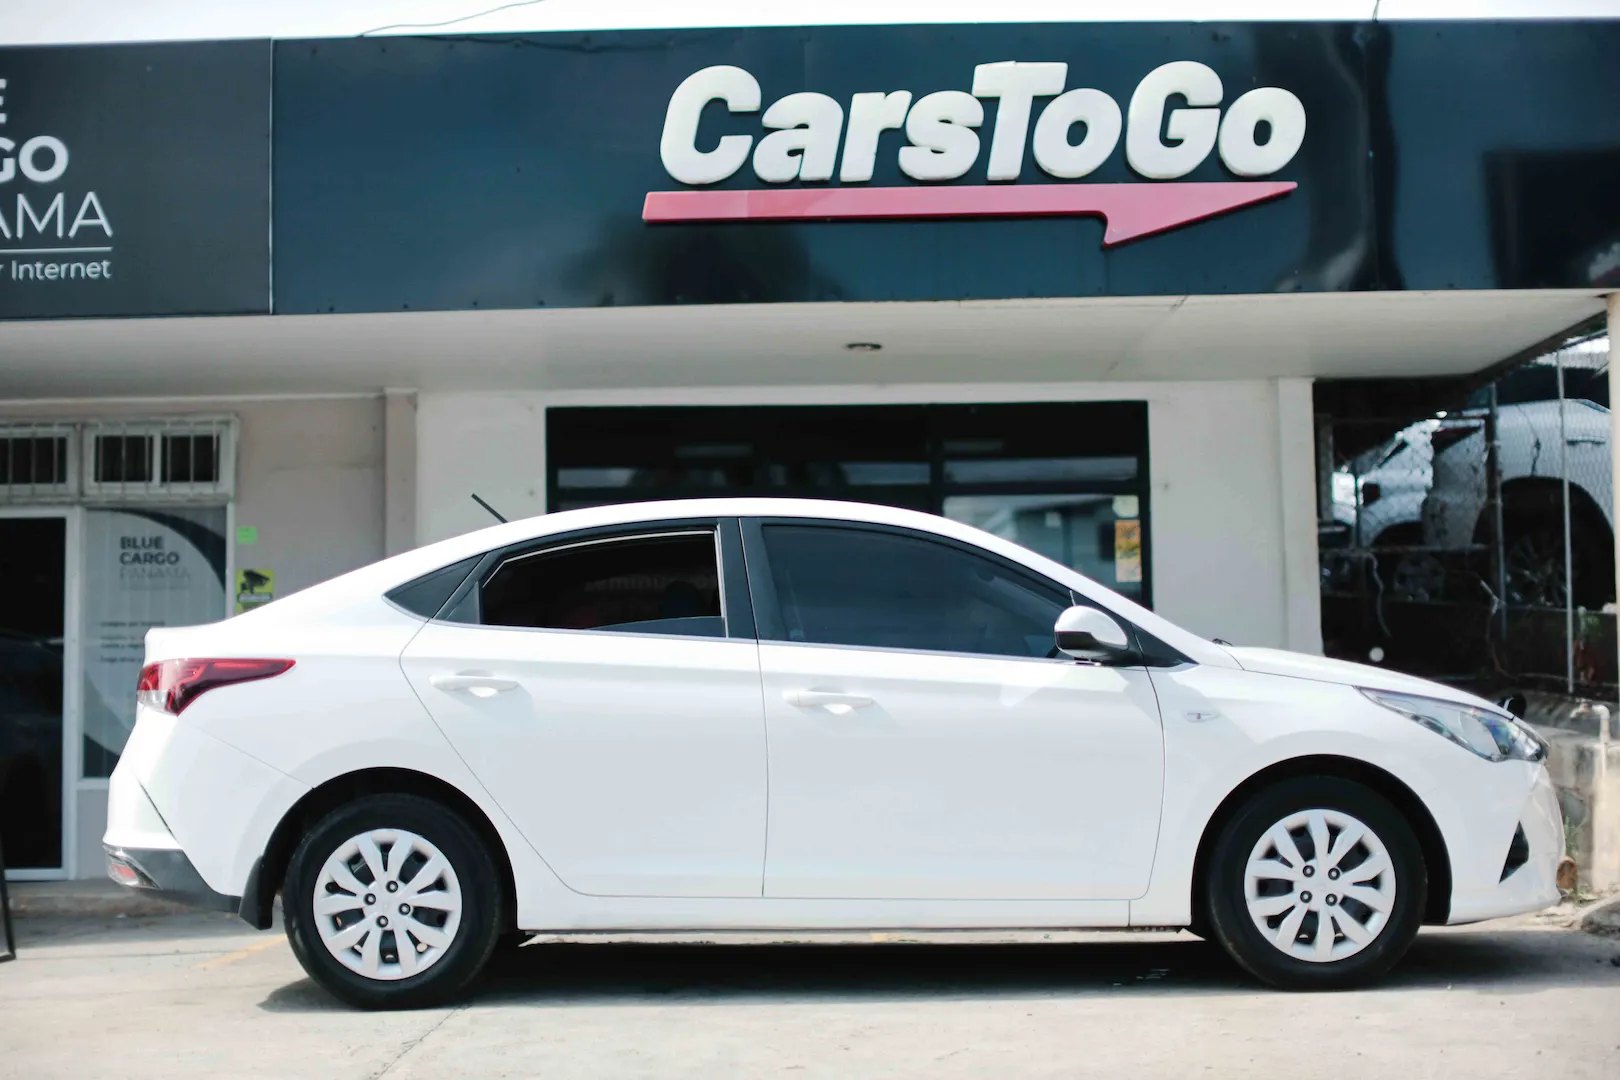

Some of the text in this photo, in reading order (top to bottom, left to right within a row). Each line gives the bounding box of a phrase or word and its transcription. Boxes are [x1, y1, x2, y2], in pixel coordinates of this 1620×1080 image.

[660, 60, 1306, 184] CarsToGo
[0, 191, 113, 239] MA
[11, 260, 111, 280] Internet
[120, 536, 163, 549] BLUE
[119, 552, 179, 565] CARGO
